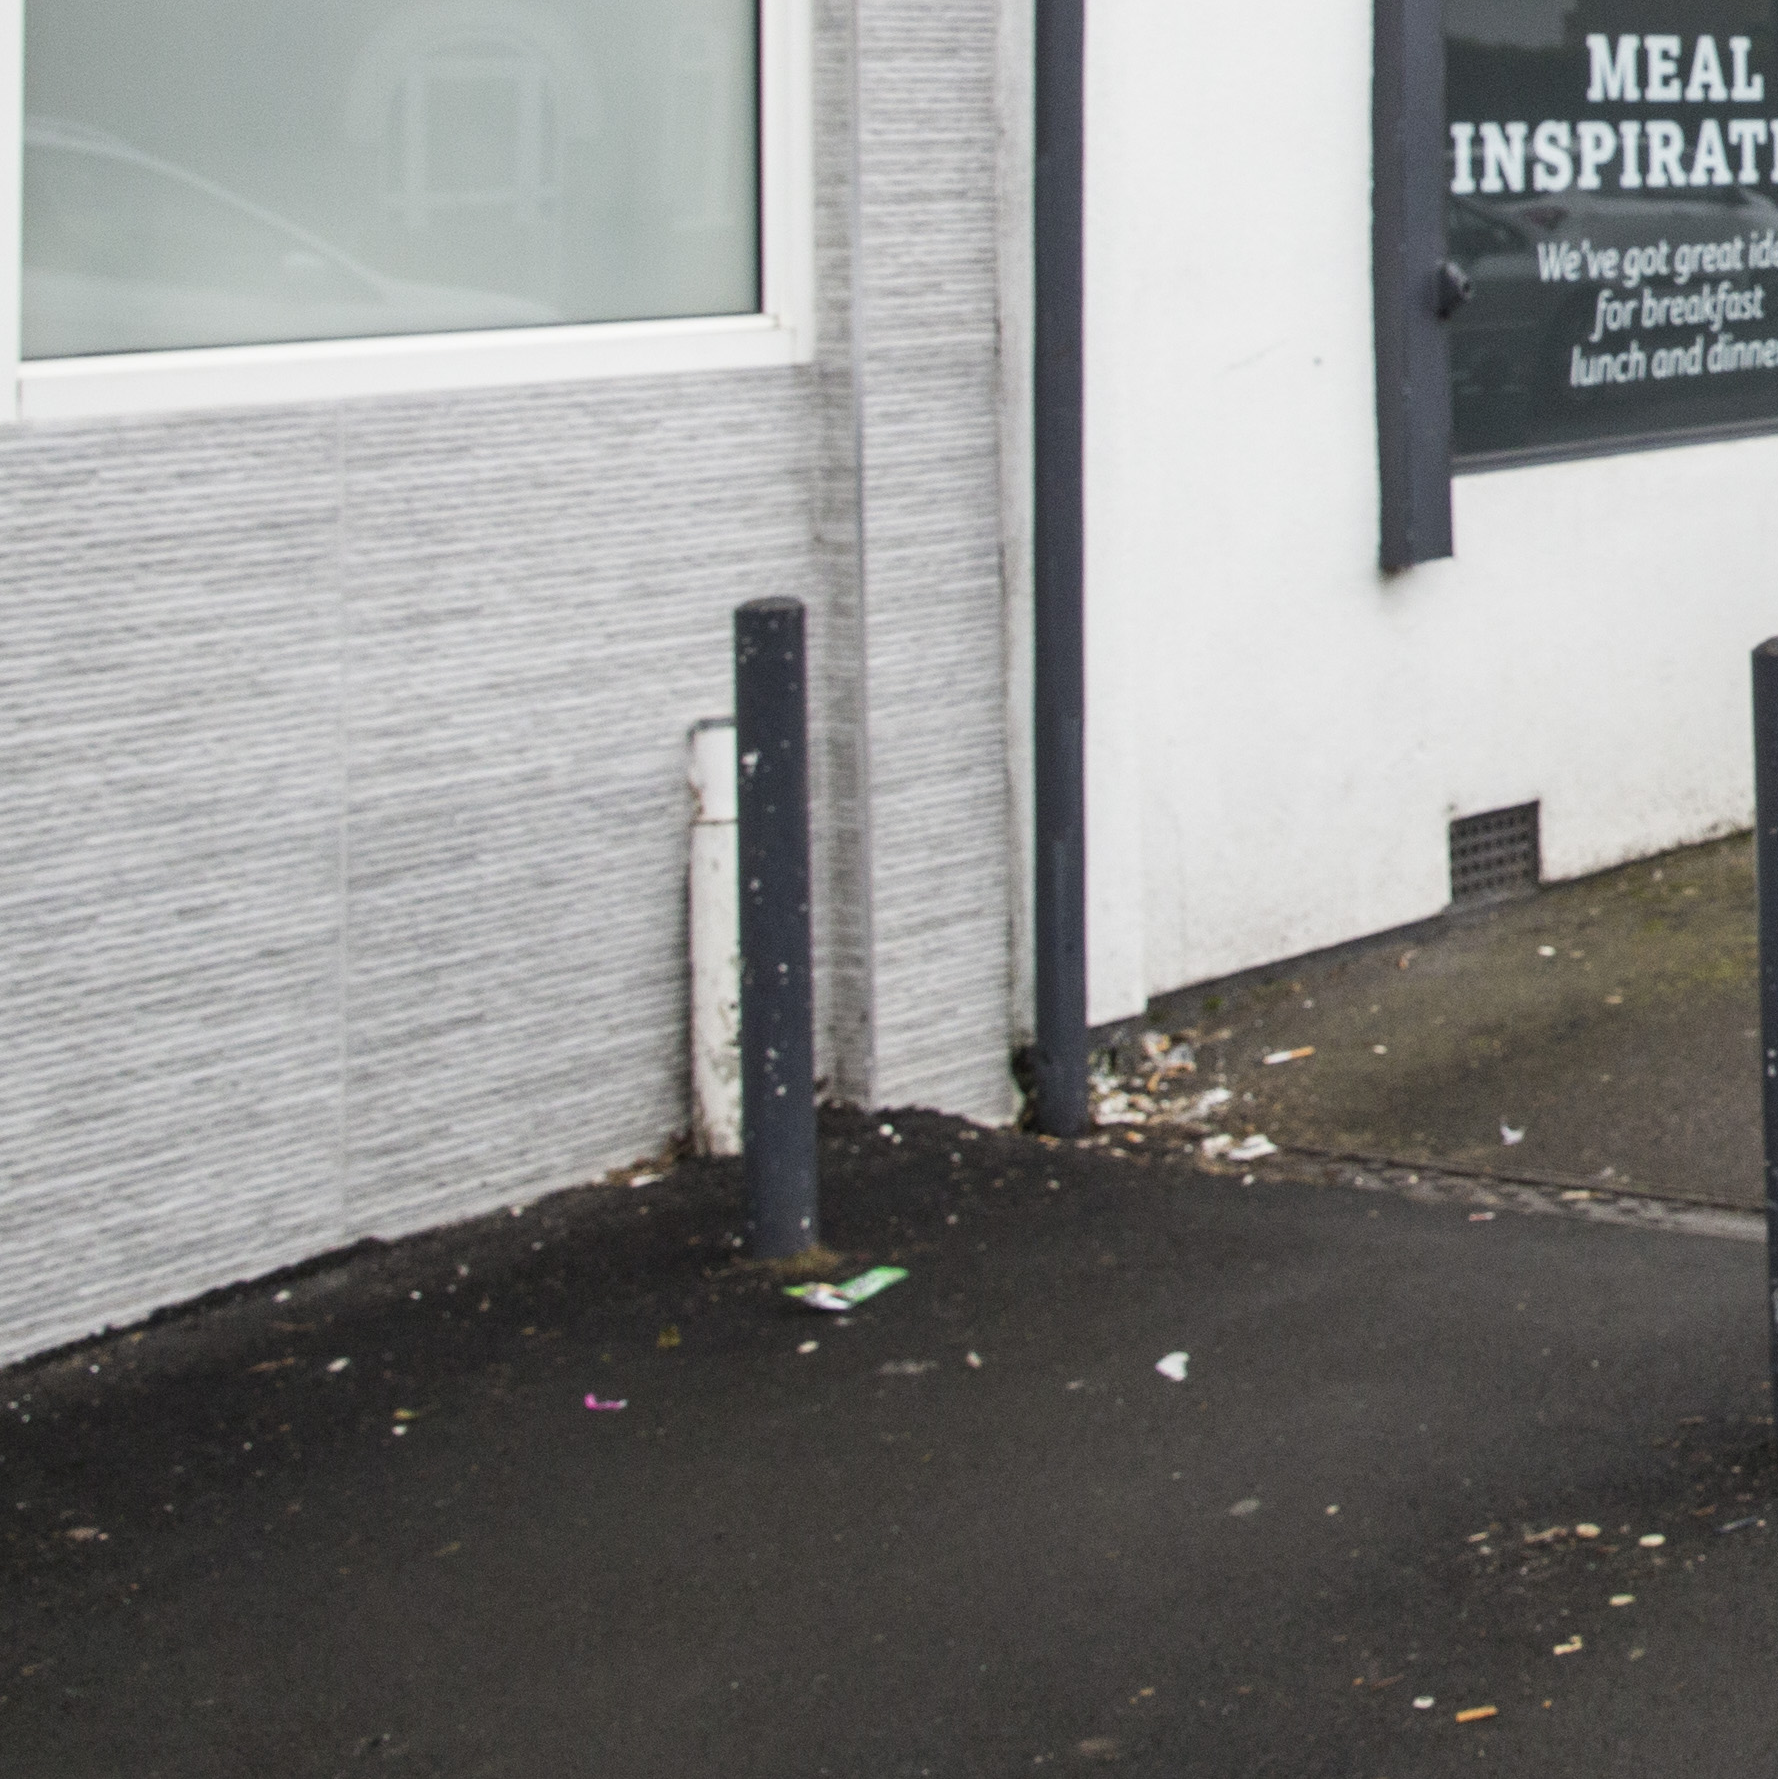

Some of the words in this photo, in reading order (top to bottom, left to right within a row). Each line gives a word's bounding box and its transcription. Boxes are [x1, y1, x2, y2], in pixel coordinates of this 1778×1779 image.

[1585, 33, 1765, 103] MEAL
[1537, 238, 1620, 283] We've
[1622, 238, 1671, 288] got
[1673, 234, 1745, 285] great
[1588, 288, 1639, 343] for
[1640, 280, 1766, 332] breakfast
[1570, 339, 1647, 388] lunch
[1651, 333, 1704, 379] and
